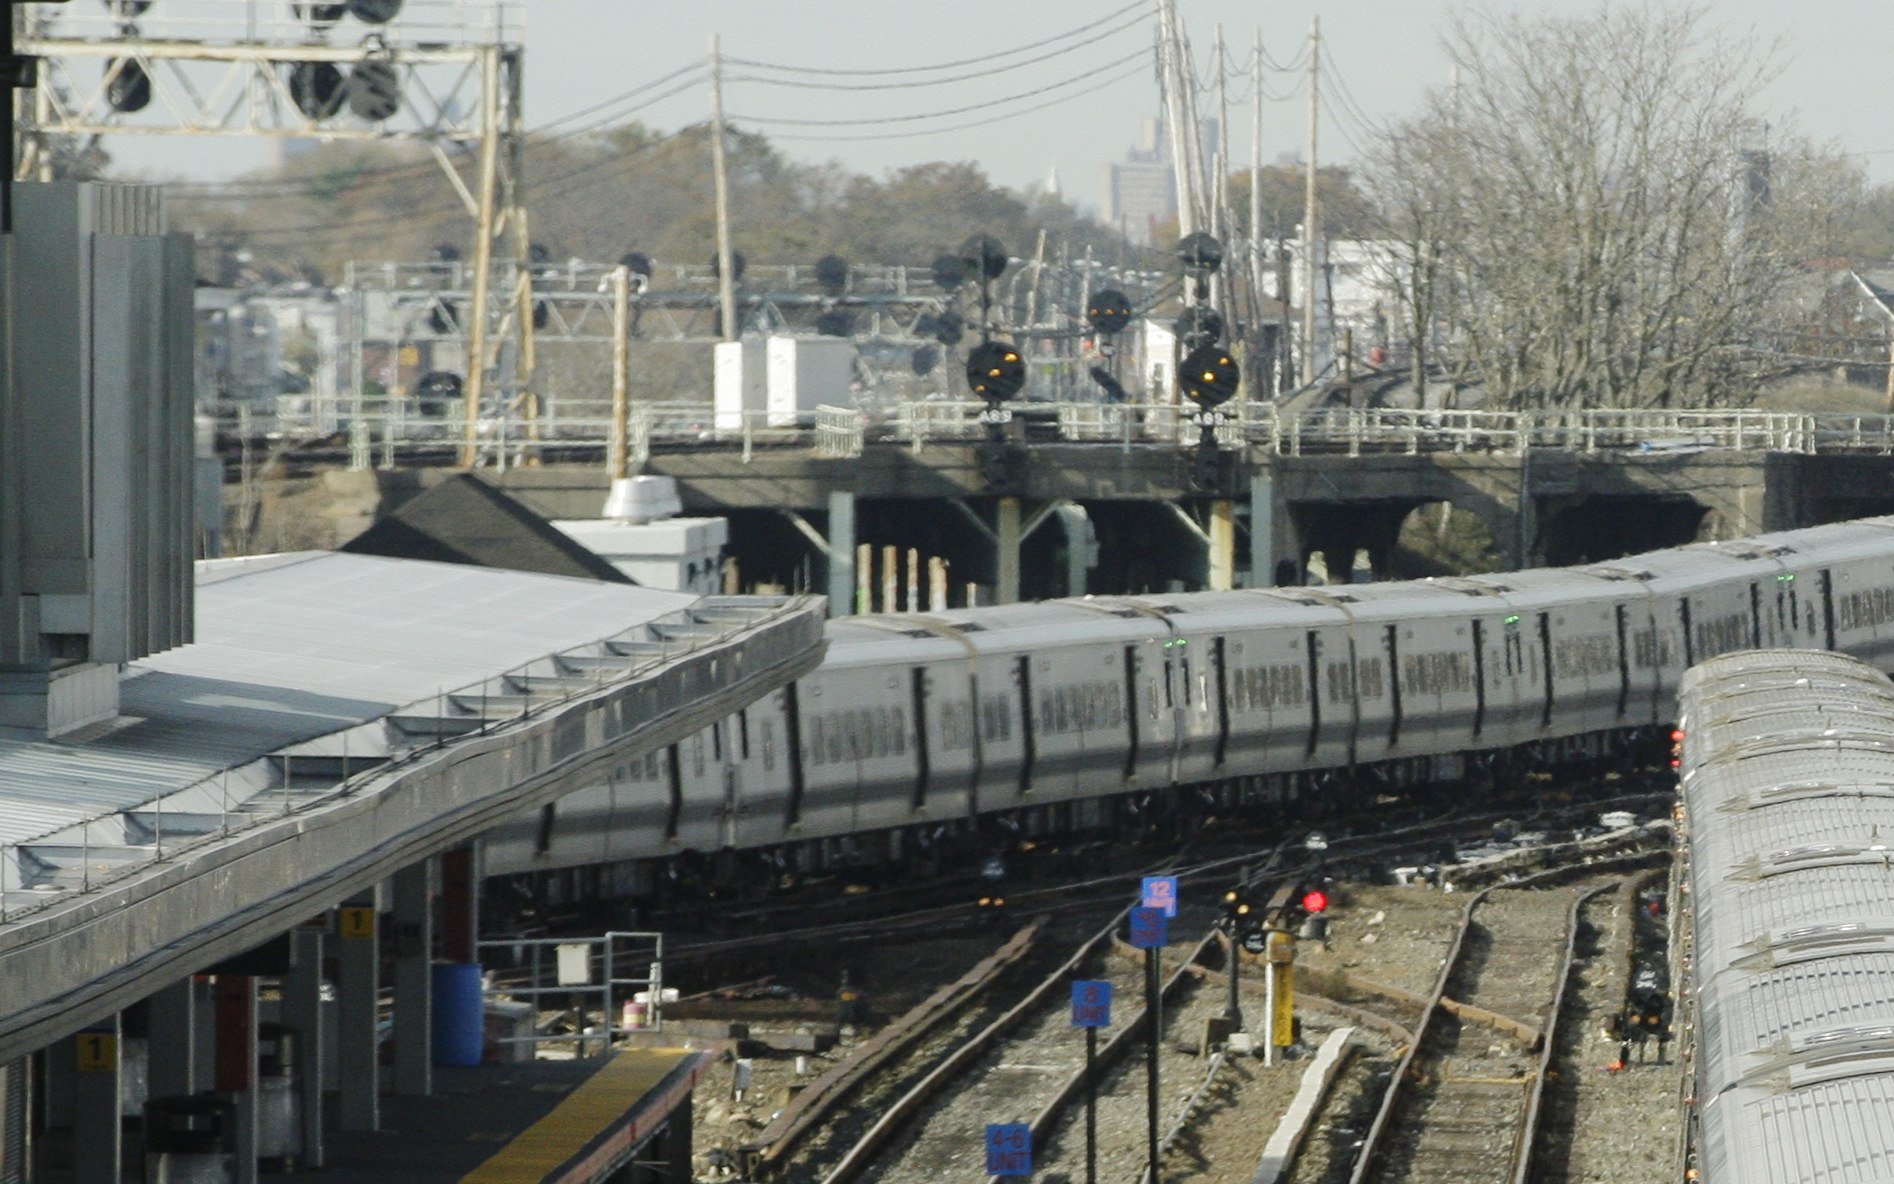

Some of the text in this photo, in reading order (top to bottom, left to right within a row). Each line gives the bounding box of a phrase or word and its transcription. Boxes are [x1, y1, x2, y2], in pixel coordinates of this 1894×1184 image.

[1150, 881, 1170, 896] 12
[351, 909, 362, 930] 1
[87, 1036, 99, 1060] 1
